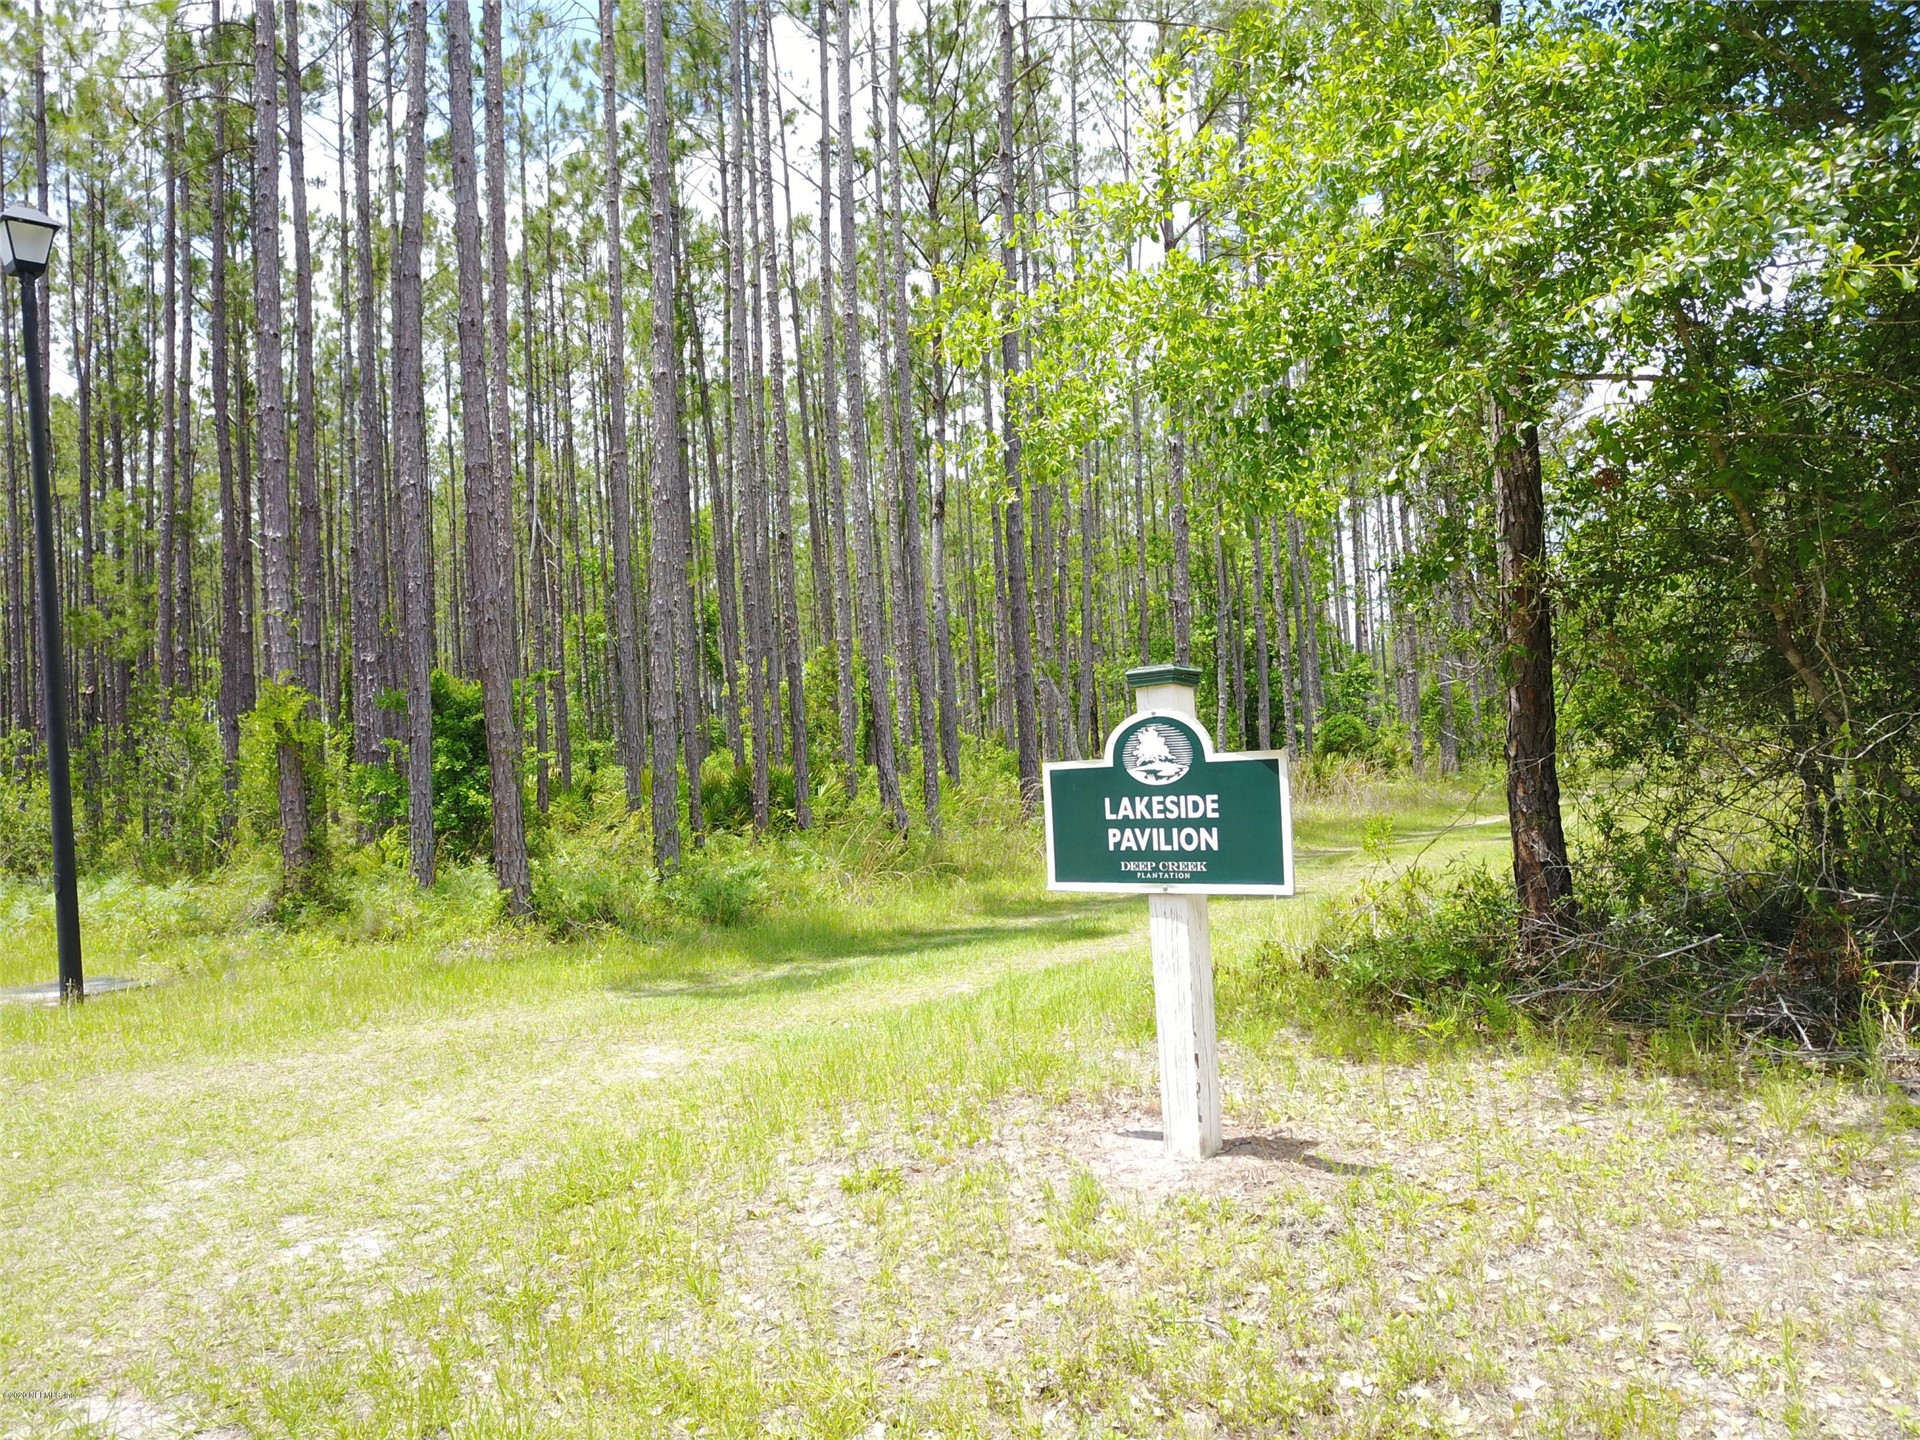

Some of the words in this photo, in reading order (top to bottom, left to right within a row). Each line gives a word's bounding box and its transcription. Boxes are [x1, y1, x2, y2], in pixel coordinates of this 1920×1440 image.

[1104, 794, 1220, 820] LAKESIDE
[1107, 827, 1219, 852] PAVILION
[1120, 861, 1156, 871] DEEP
[1158, 861, 1208, 872] CREEK
